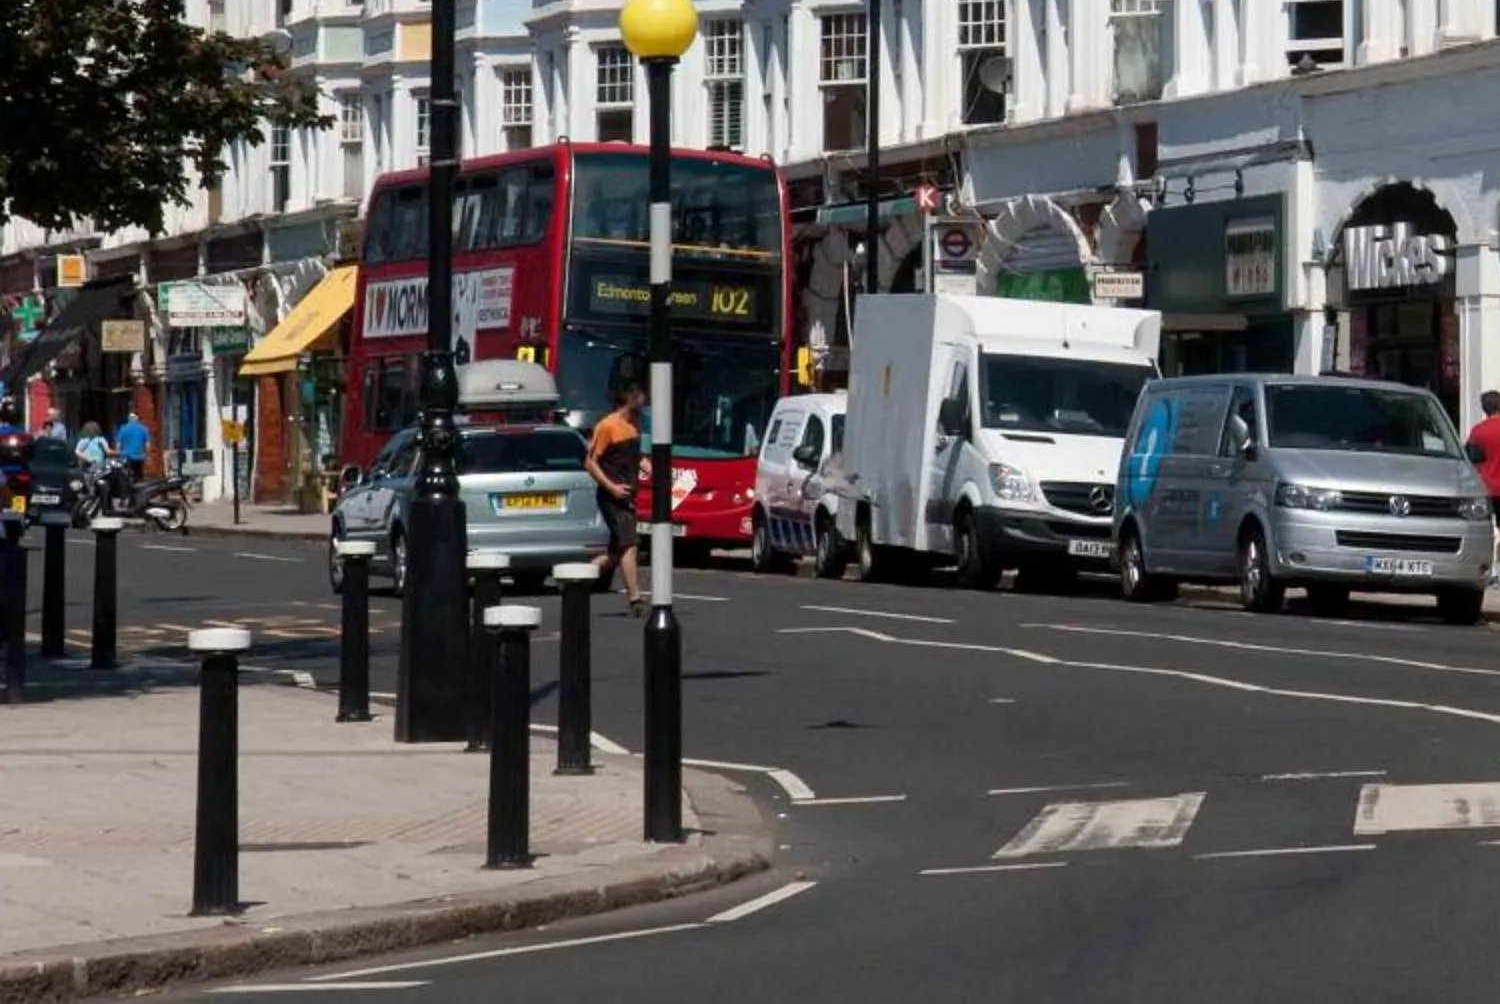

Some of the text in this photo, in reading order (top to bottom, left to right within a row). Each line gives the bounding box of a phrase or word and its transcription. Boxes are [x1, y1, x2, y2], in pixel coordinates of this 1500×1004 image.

[919, 188, 935, 207] K
[1344, 221, 1448, 291] Wickes
[597, 282, 698, 306] Edmonto reen
[711, 284, 750, 315] 102
